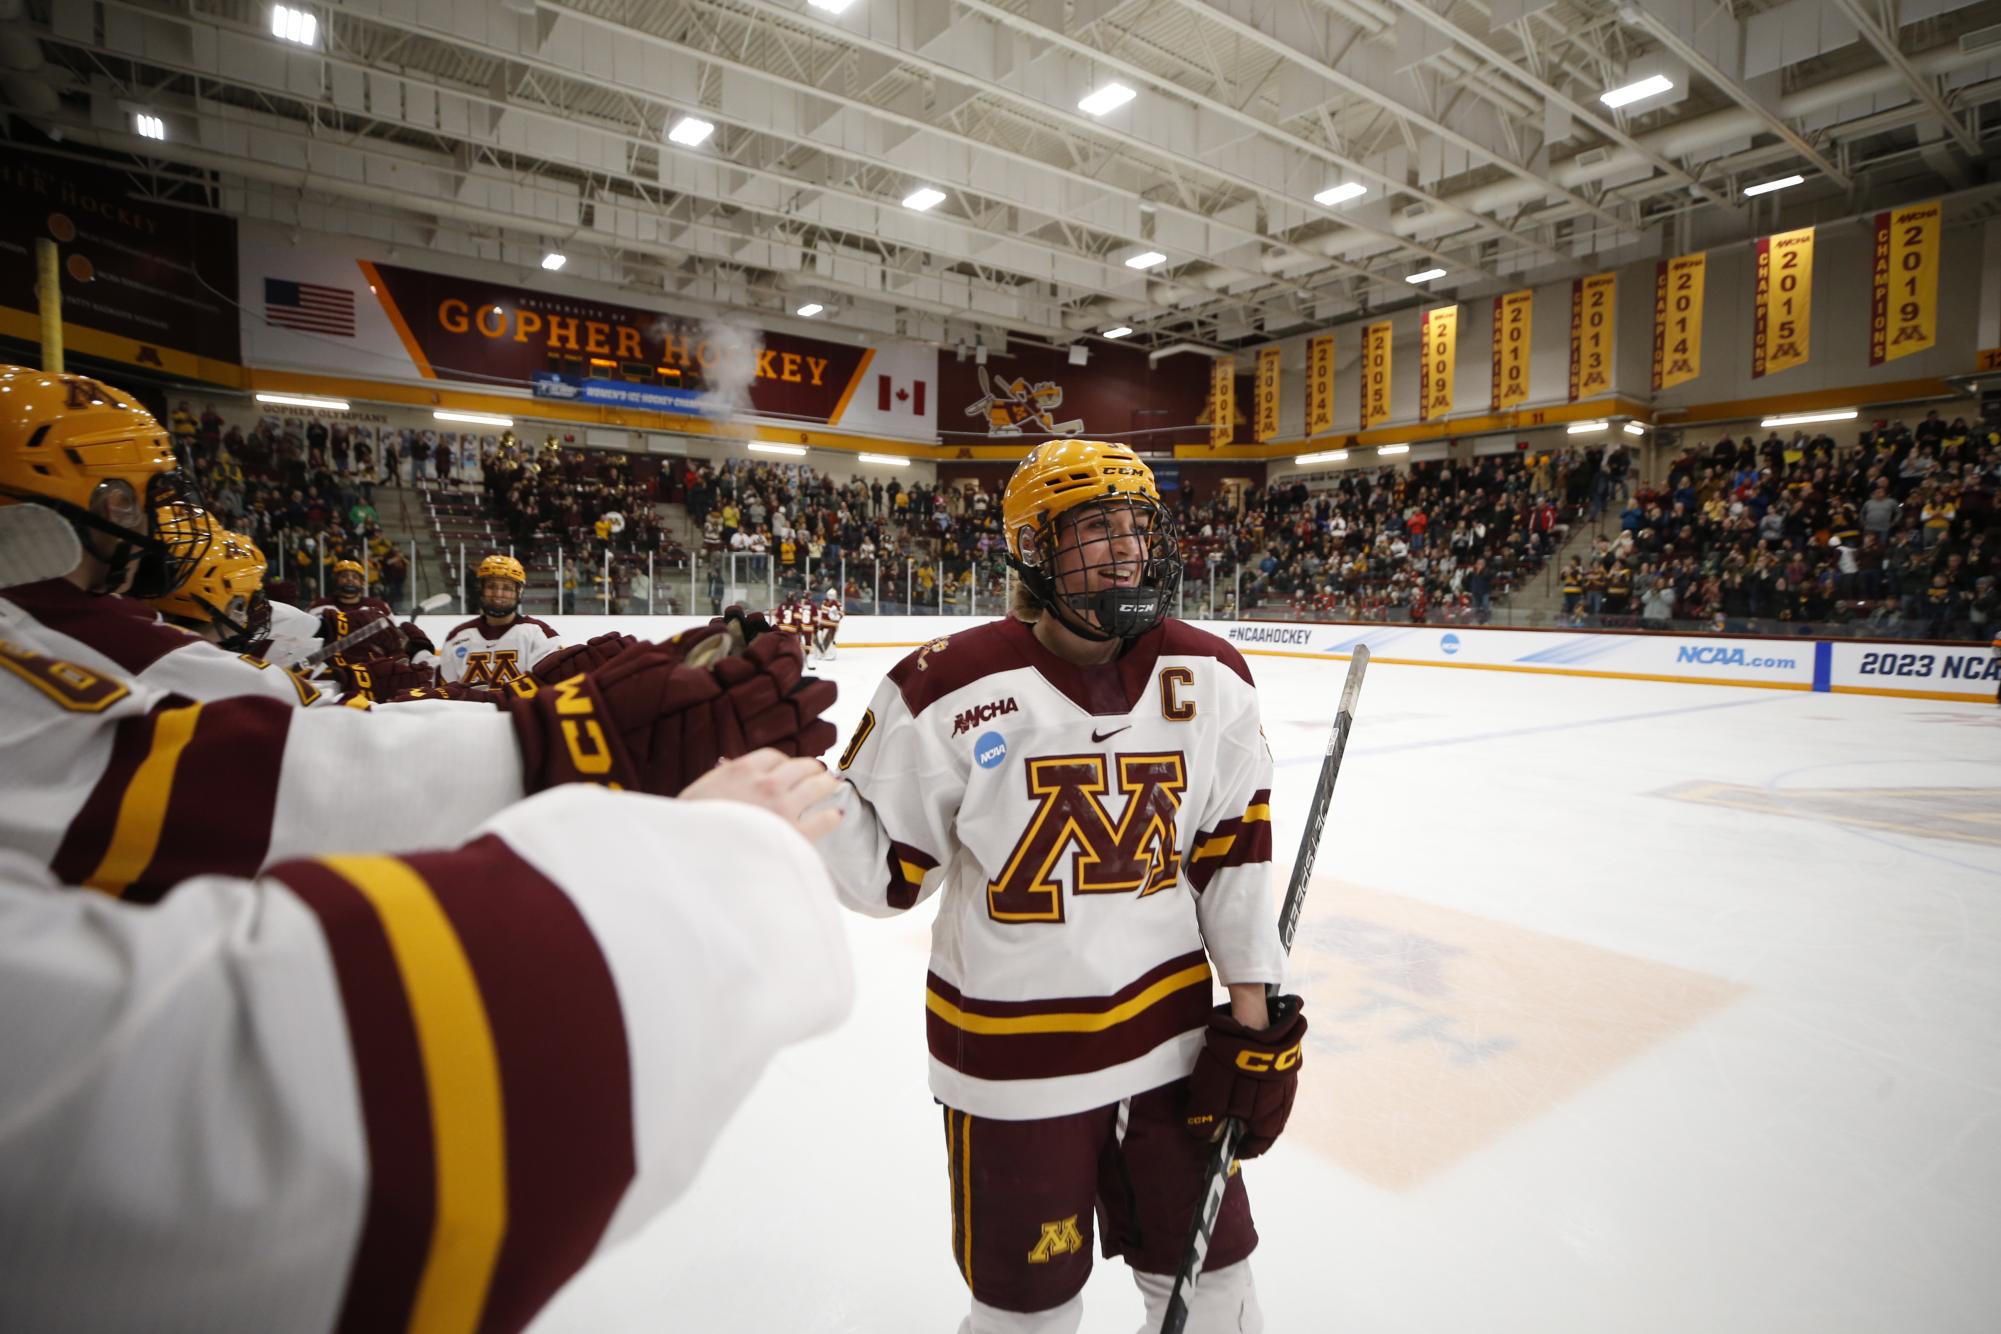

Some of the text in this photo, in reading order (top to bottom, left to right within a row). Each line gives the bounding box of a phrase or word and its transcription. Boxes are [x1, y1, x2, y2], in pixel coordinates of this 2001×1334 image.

[1779, 252, 1798, 339] 2015
[1873, 230, 1889, 356] CHAMPIONS
[1899, 226, 1923, 321] 2019
[438, 299, 644, 360] GOPHER
[1589, 291, 1604, 368] 2013
[1673, 273, 1691, 354] 2014
[1755, 253, 1769, 372] CHAMPIONS
[1373, 337, 1384, 402] 2005
[1435, 323, 1448, 392] 2009
[1508, 307, 1522, 381] 2010
[263, 404, 388, 423] GOPHER OLYMPIANS
[1102, 467, 1144, 477] CCM
[1119, 603, 1154, 613] CCM
[1228, 626, 1312, 645] #NCAAHOCKEY
[1676, 645, 1797, 670] NCAA.com
[1860, 652, 1935, 677] 2023
[1159, 666, 1197, 722] C
[980, 743, 1007, 765] NCAA
[986, 750, 1188, 924] M
[1187, 1114, 1213, 1125] CCM
[1027, 1213, 1083, 1264] M
